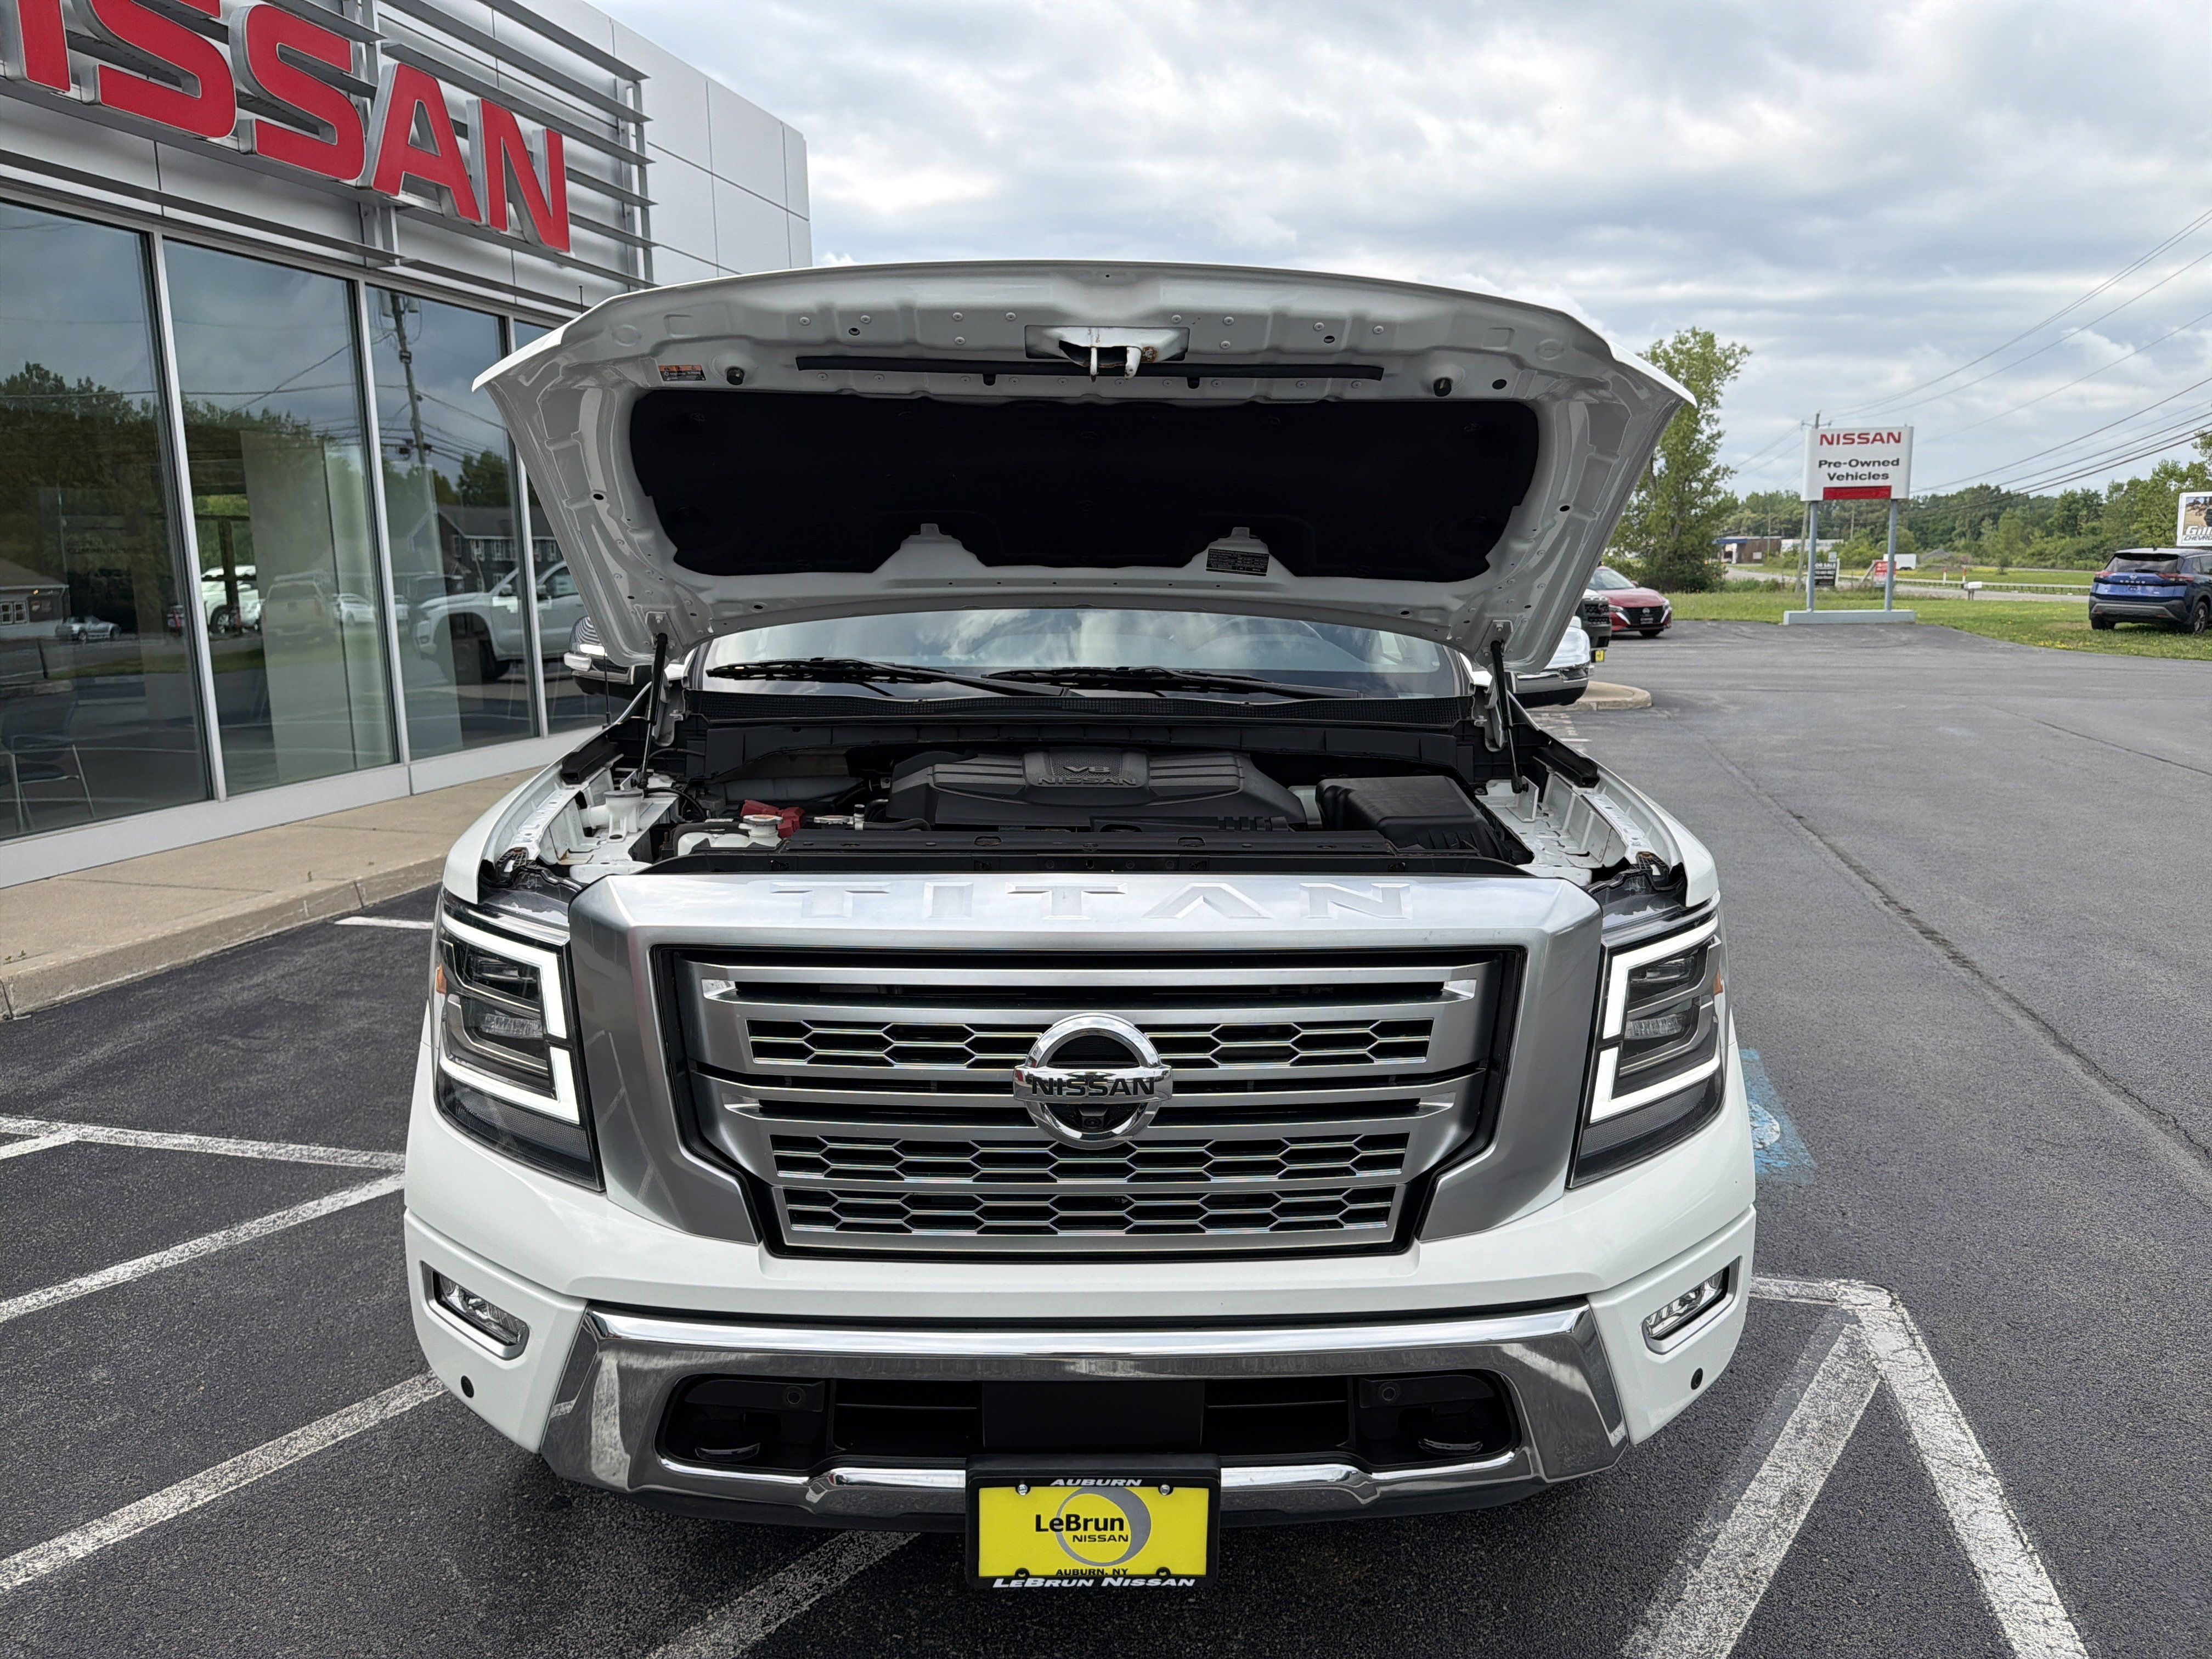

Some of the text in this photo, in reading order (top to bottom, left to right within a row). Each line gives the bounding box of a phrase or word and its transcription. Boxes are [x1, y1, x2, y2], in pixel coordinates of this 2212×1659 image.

[1820, 432, 1901, 445] NISSAN
[1819, 458, 1899, 468] Pre-Owned
[1827, 472, 1889, 481] Vehicles
[1038, 777, 1136, 786] NISSAN
[769, 881, 1413, 919] TITAN
[1032, 1077, 1154, 1096] NISSAN
[1035, 1514, 1124, 1532] LeBrun
[1072, 1534, 1128, 1543] NISSAN
[1101, 1577, 1195, 1587] NISSAN
